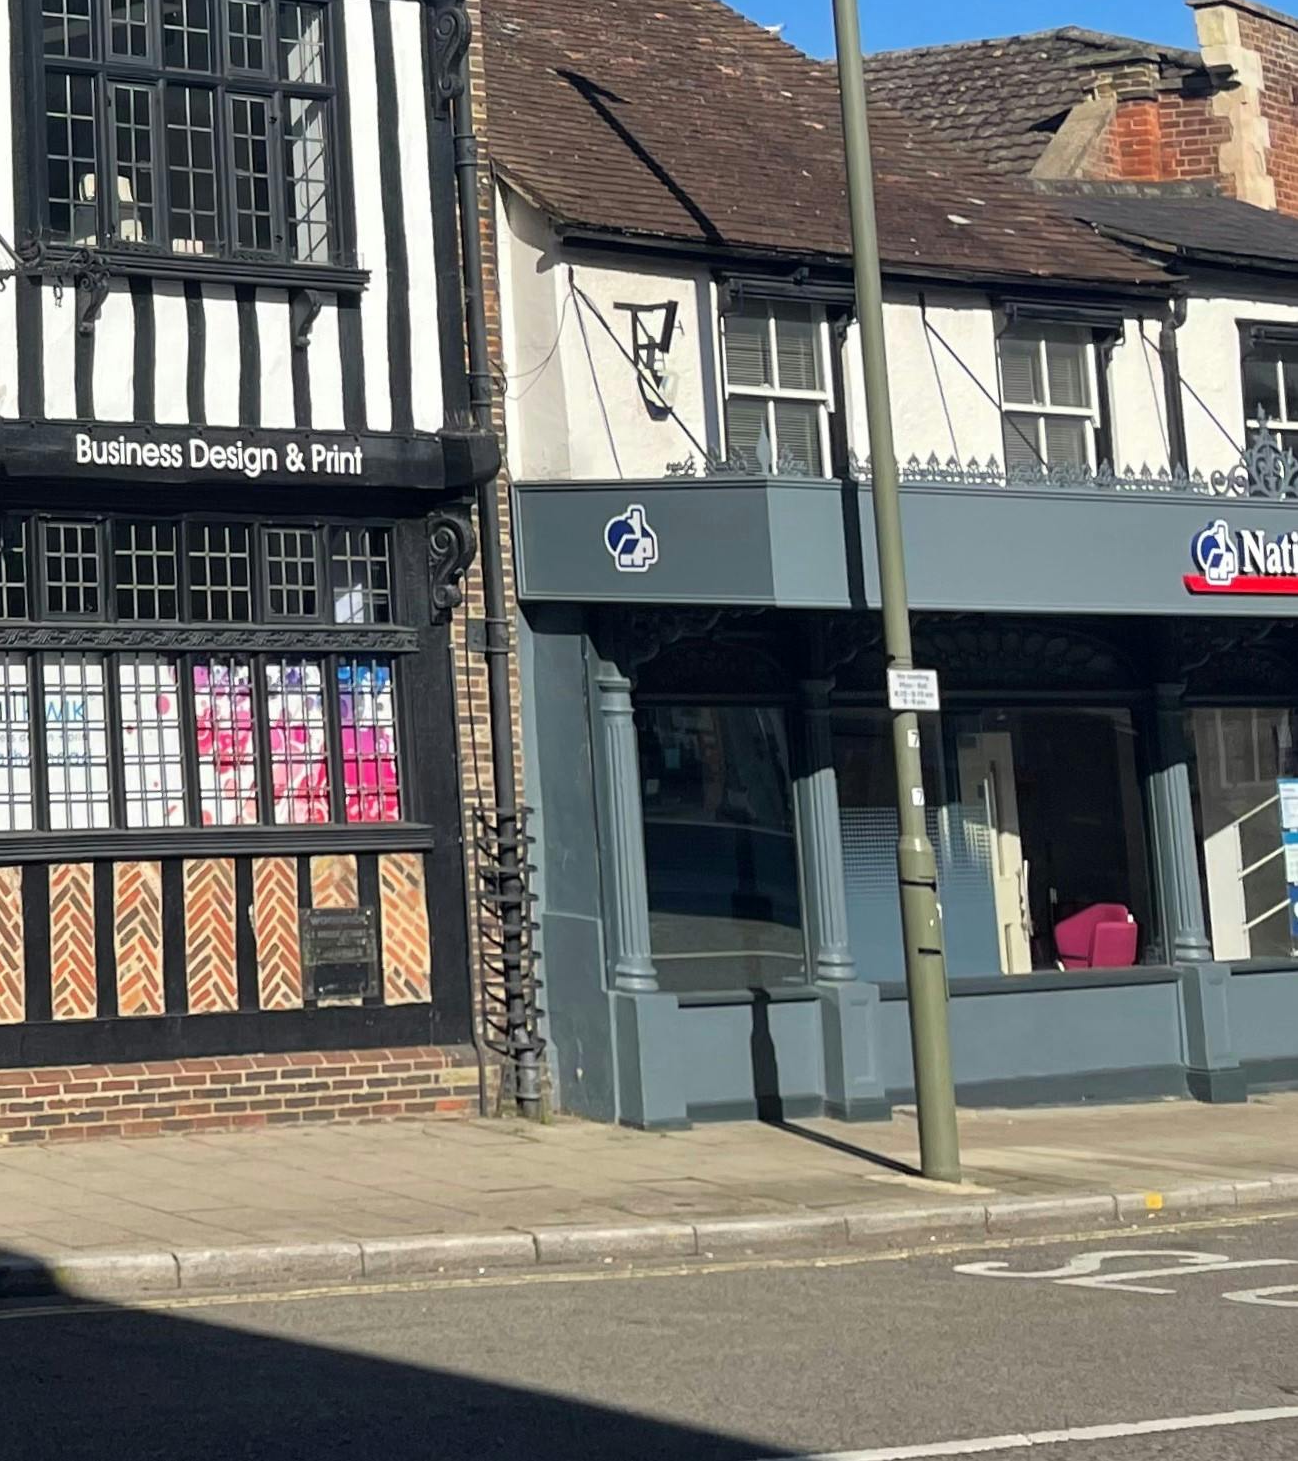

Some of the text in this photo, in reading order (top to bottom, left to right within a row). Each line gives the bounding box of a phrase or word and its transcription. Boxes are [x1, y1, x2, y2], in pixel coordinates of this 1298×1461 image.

[75, 433, 363, 478] Business Design & Print
